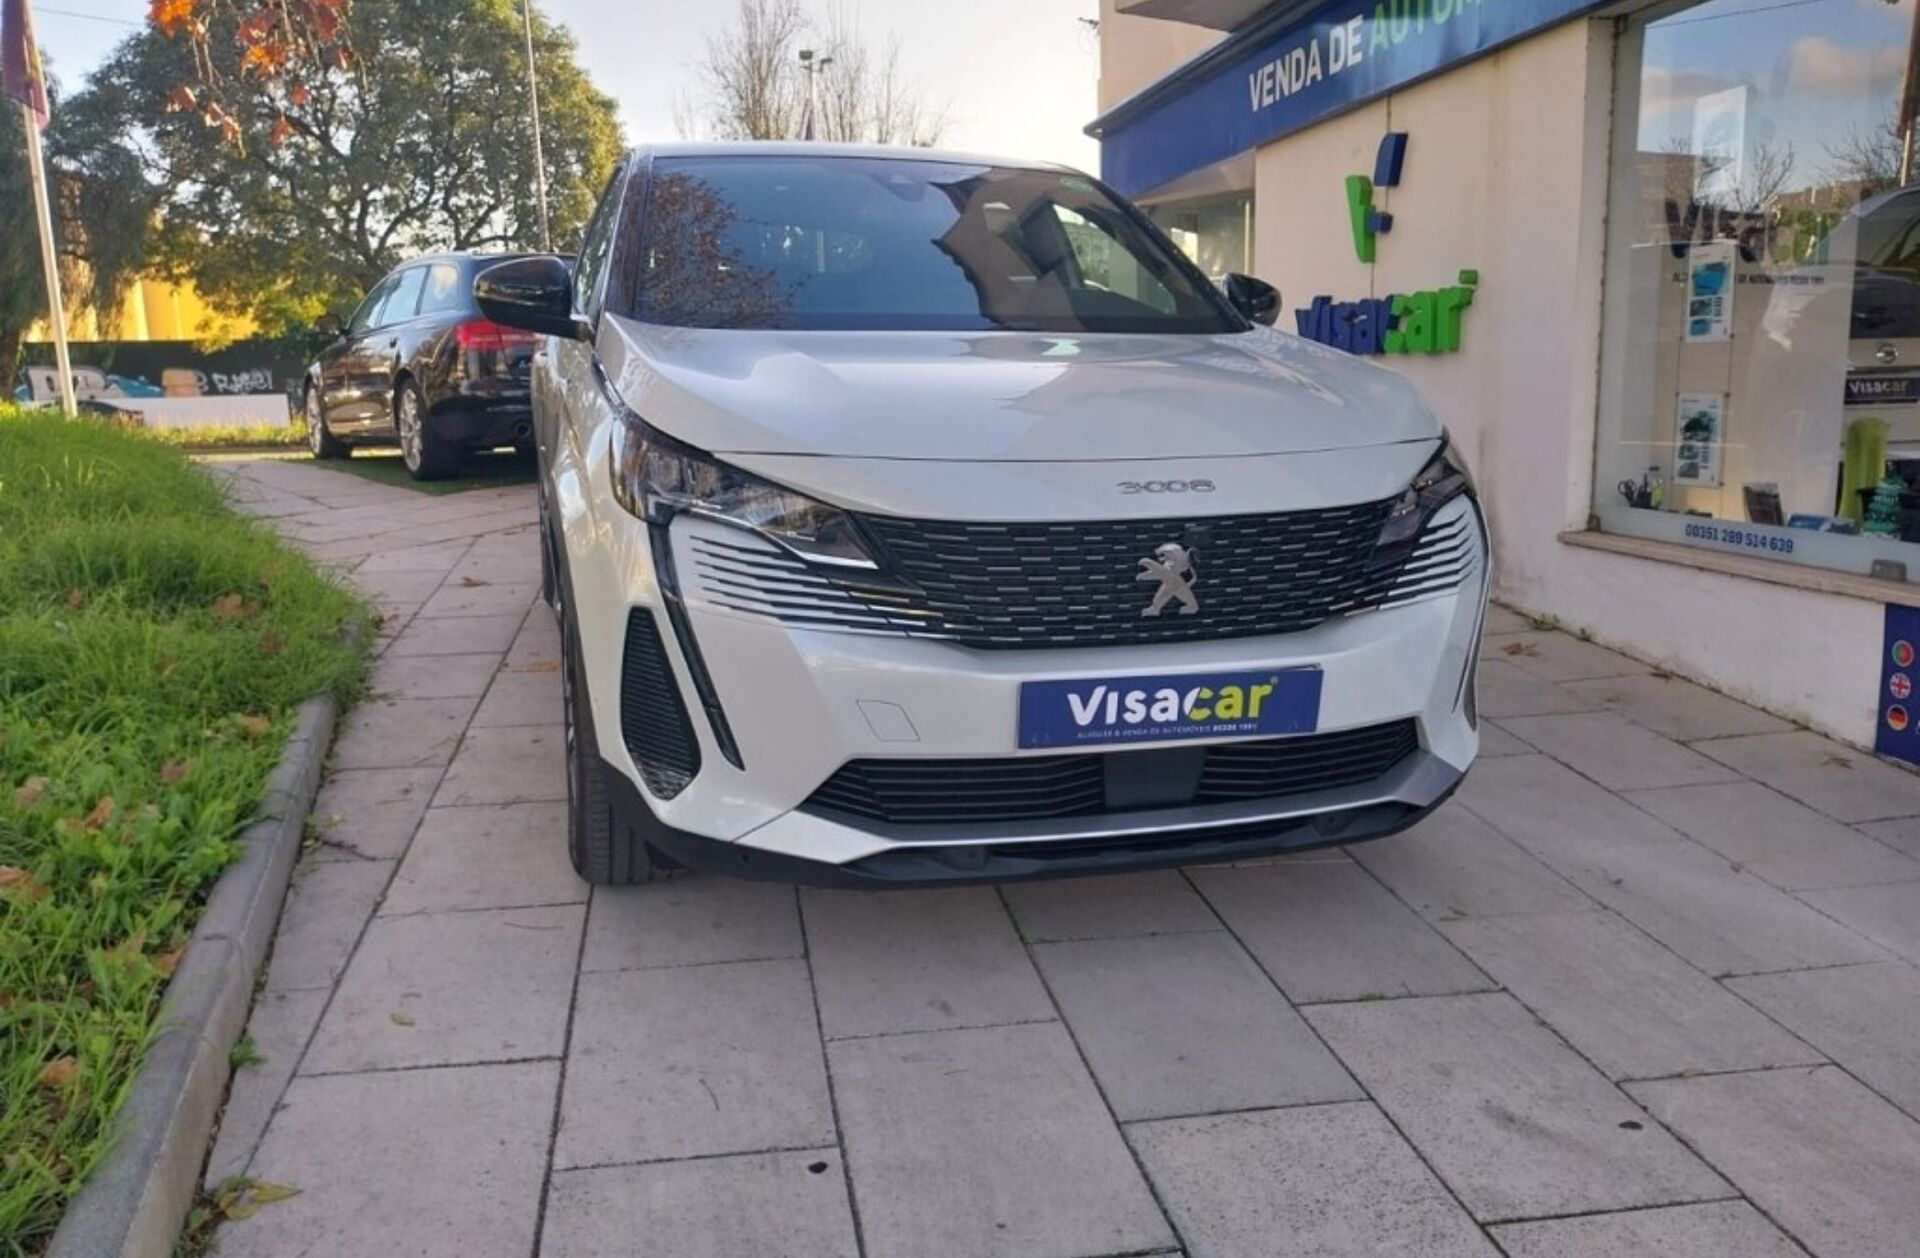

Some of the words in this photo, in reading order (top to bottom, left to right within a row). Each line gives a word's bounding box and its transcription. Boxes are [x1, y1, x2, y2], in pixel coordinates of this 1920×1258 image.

[1249, 38, 1322, 112] VENDA
[1328, 14, 1364, 75] DE
[1116, 479, 1216, 494] 3008
[1684, 523, 1718, 541] 00351
[1745, 532, 1767, 548] 514
[1769, 536, 1794, 553] 639
